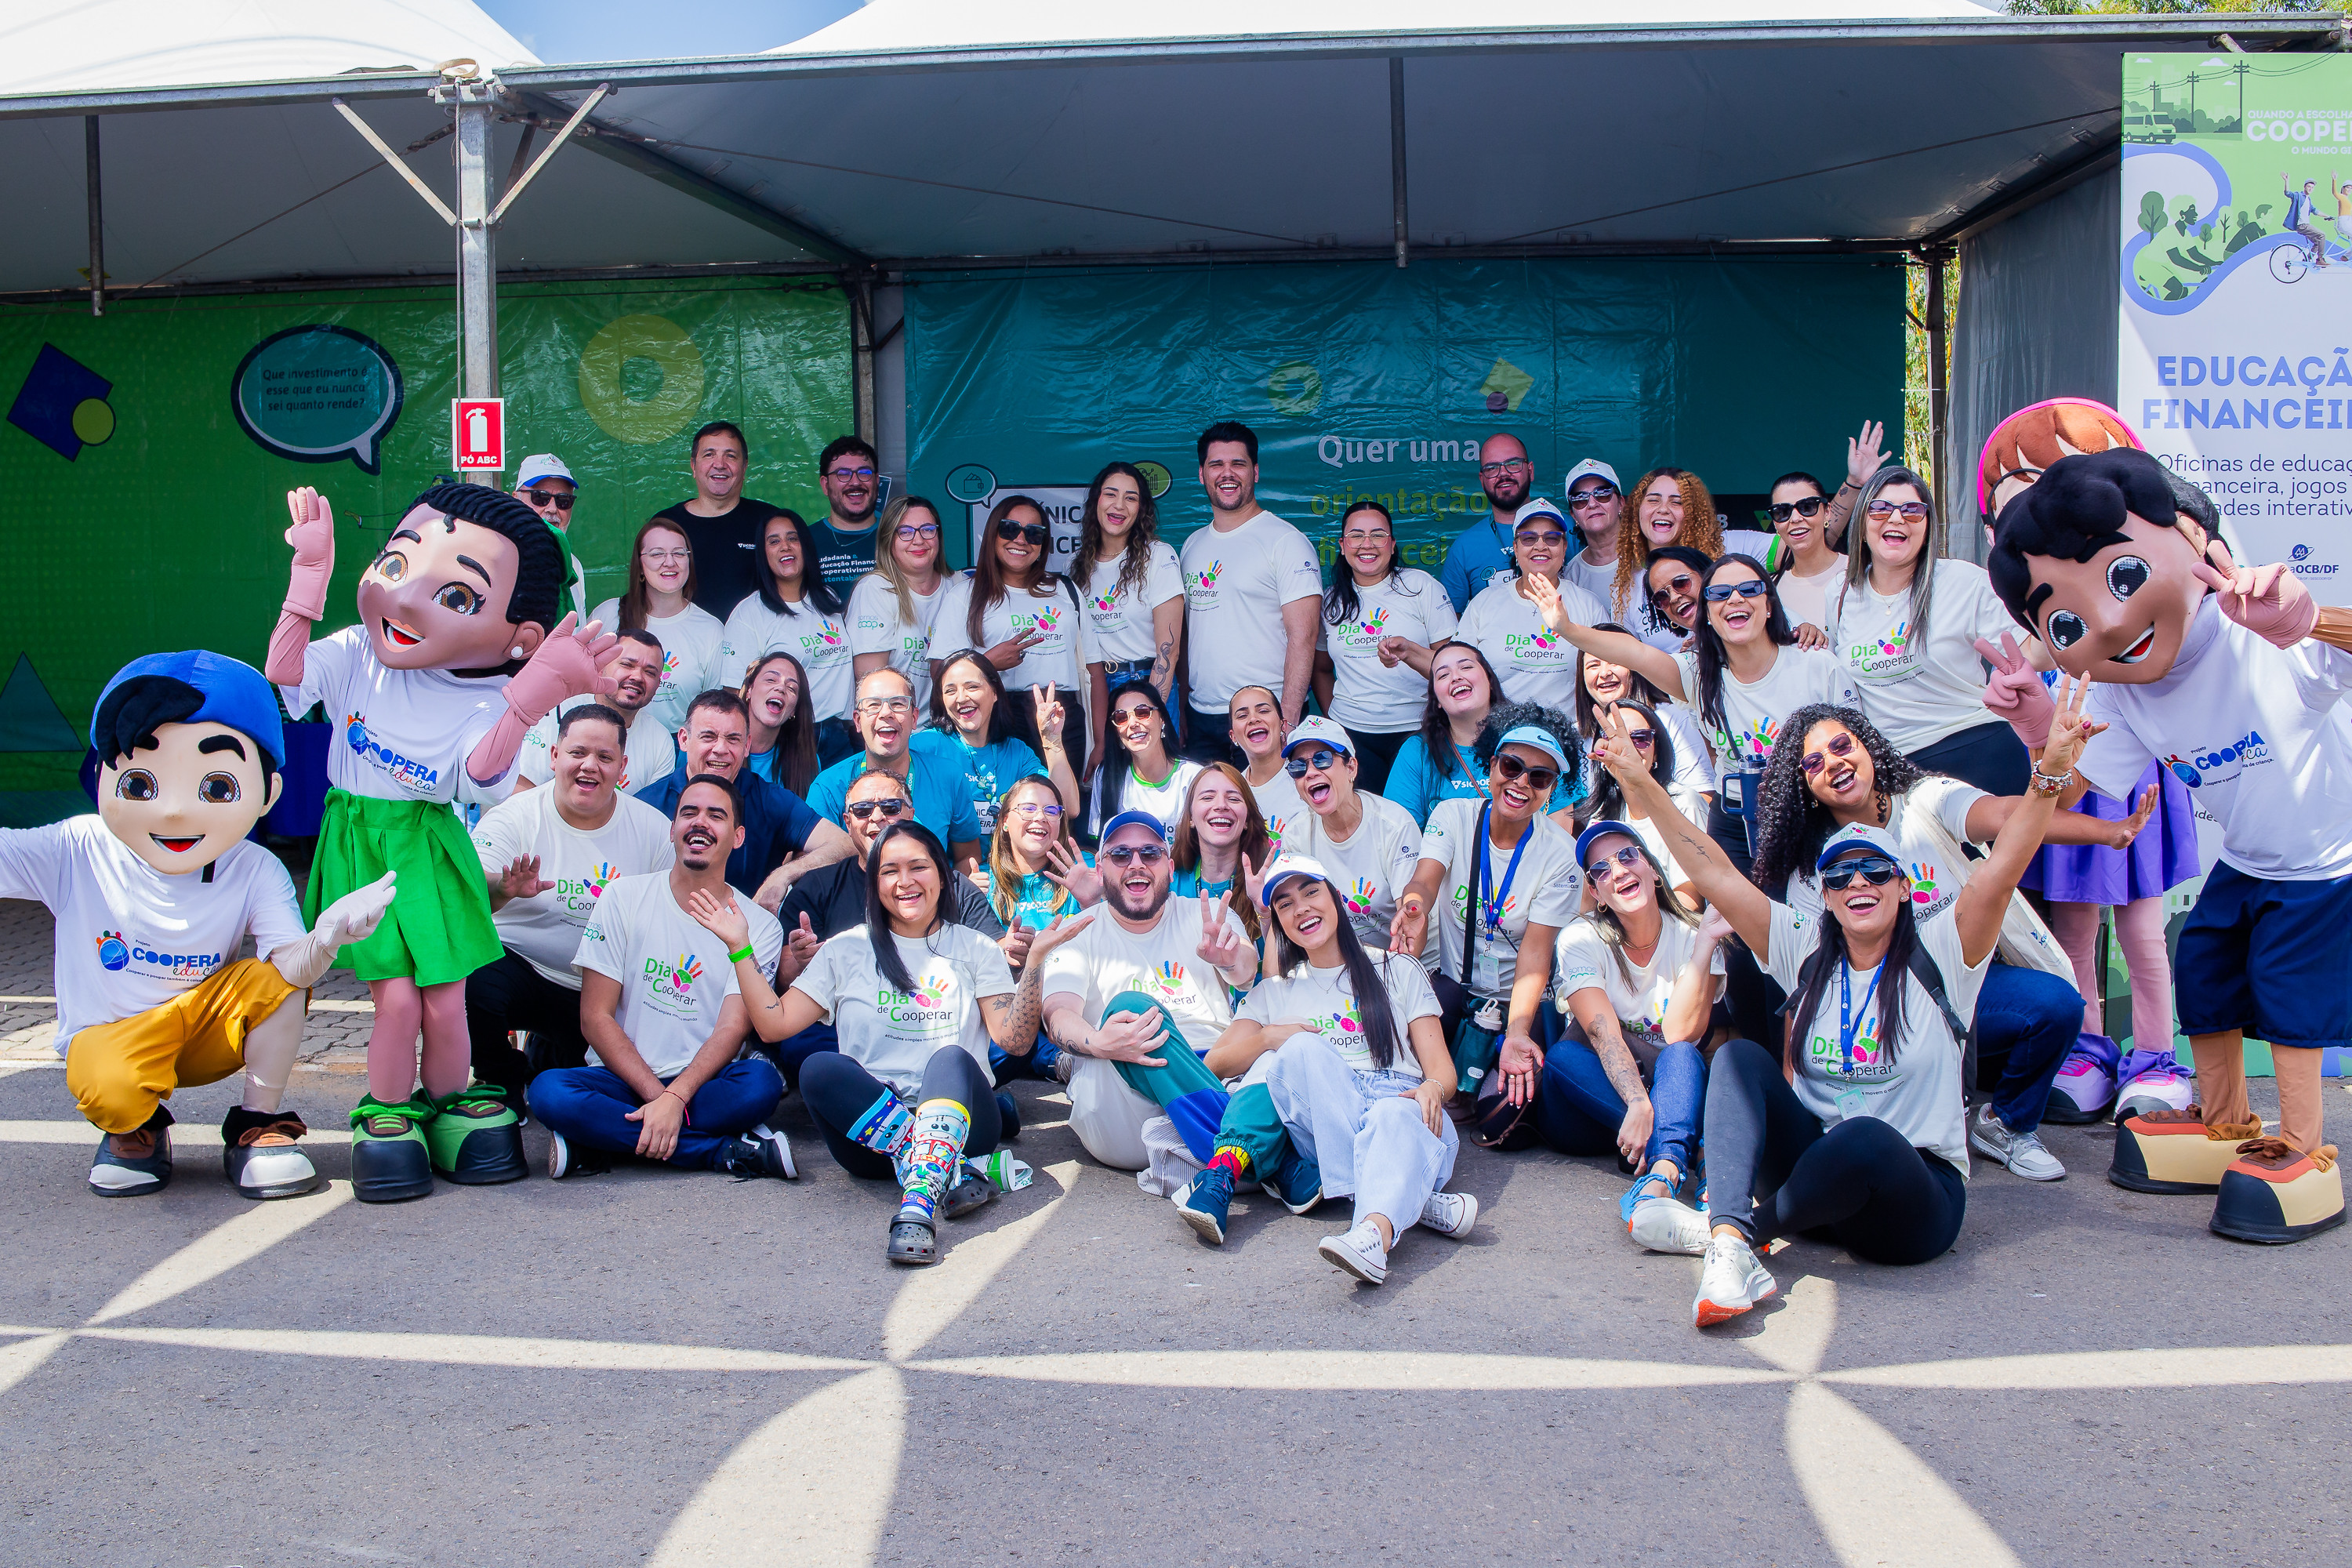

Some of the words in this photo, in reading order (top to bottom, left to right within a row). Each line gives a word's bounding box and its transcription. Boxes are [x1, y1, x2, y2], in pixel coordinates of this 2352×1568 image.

[2248, 110, 2294, 119] QUANDO
[2295, 110, 2304, 118] A
[2247, 120, 2352, 143] COOPE
[2291, 147, 2299, 155] O
[2302, 147, 2339, 155] MUNDO
[263, 369, 285, 382] Que
[289, 367, 358, 379] investimento
[2158, 347, 2352, 397] EDUCAÇÃ
[266, 386, 289, 395] esse
[292, 385, 313, 397] que
[315, 385, 328, 394] eu
[332, 383, 365, 393] nunca
[268, 401, 283, 412] sei
[286, 400, 325, 413] quanto
[328, 398, 365, 409] rende?
[2143, 398, 2352, 429] FINANCEI
[1318, 434, 1399, 469] Quer
[1410, 439, 1480, 463] uma
[461, 454, 474, 464] PÓ
[477, 456, 498, 464] ABC
[2156, 453, 2243, 472] Oficinas
[2249, 453, 2275, 472] de
[2281, 453, 2352, 475] educaç
[2290, 477, 2347, 499] jogos
[2267, 499, 2352, 517] interativ
[1188, 586, 1219, 598] Cooperar
[1011, 614, 1034, 627] Dia
[1091, 611, 1123, 622] ooperar
[1338, 623, 1360, 635] Dia
[799, 634, 822, 648] Dia
[904, 636, 924, 650] Dia
[1505, 633, 1530, 646] Dia
[813, 644, 849, 657] Cooperar
[1515, 647, 1565, 660] Cooperar
[1851, 642, 1878, 659] Dia
[1850, 659, 1860, 667] de
[1861, 653, 1915, 673] Cooperar
[363, 726, 379, 738] Projeto
[2190, 746, 2207, 755] Projeto
[390, 766, 437, 792] educa
[557, 879, 585, 896] Dia
[1450, 899, 1461, 909] de
[135, 938, 151, 947] Projeto
[132, 947, 221, 967] COOPERA
[125, 967, 147, 977] Cooperar
[172, 962, 221, 977] educa
[644, 957, 671, 978] Dia
[643, 974, 653, 982] de
[1132, 978, 1159, 993] Dia
[877, 990, 909, 1005] Dia
[877, 1005, 888, 1014] de
[890, 1007, 953, 1023] Cooperar
[884, 1033, 904, 1042] atitudes
[1813, 1036, 1843, 1058] Dia
[1811, 1056, 1824, 1065] de
